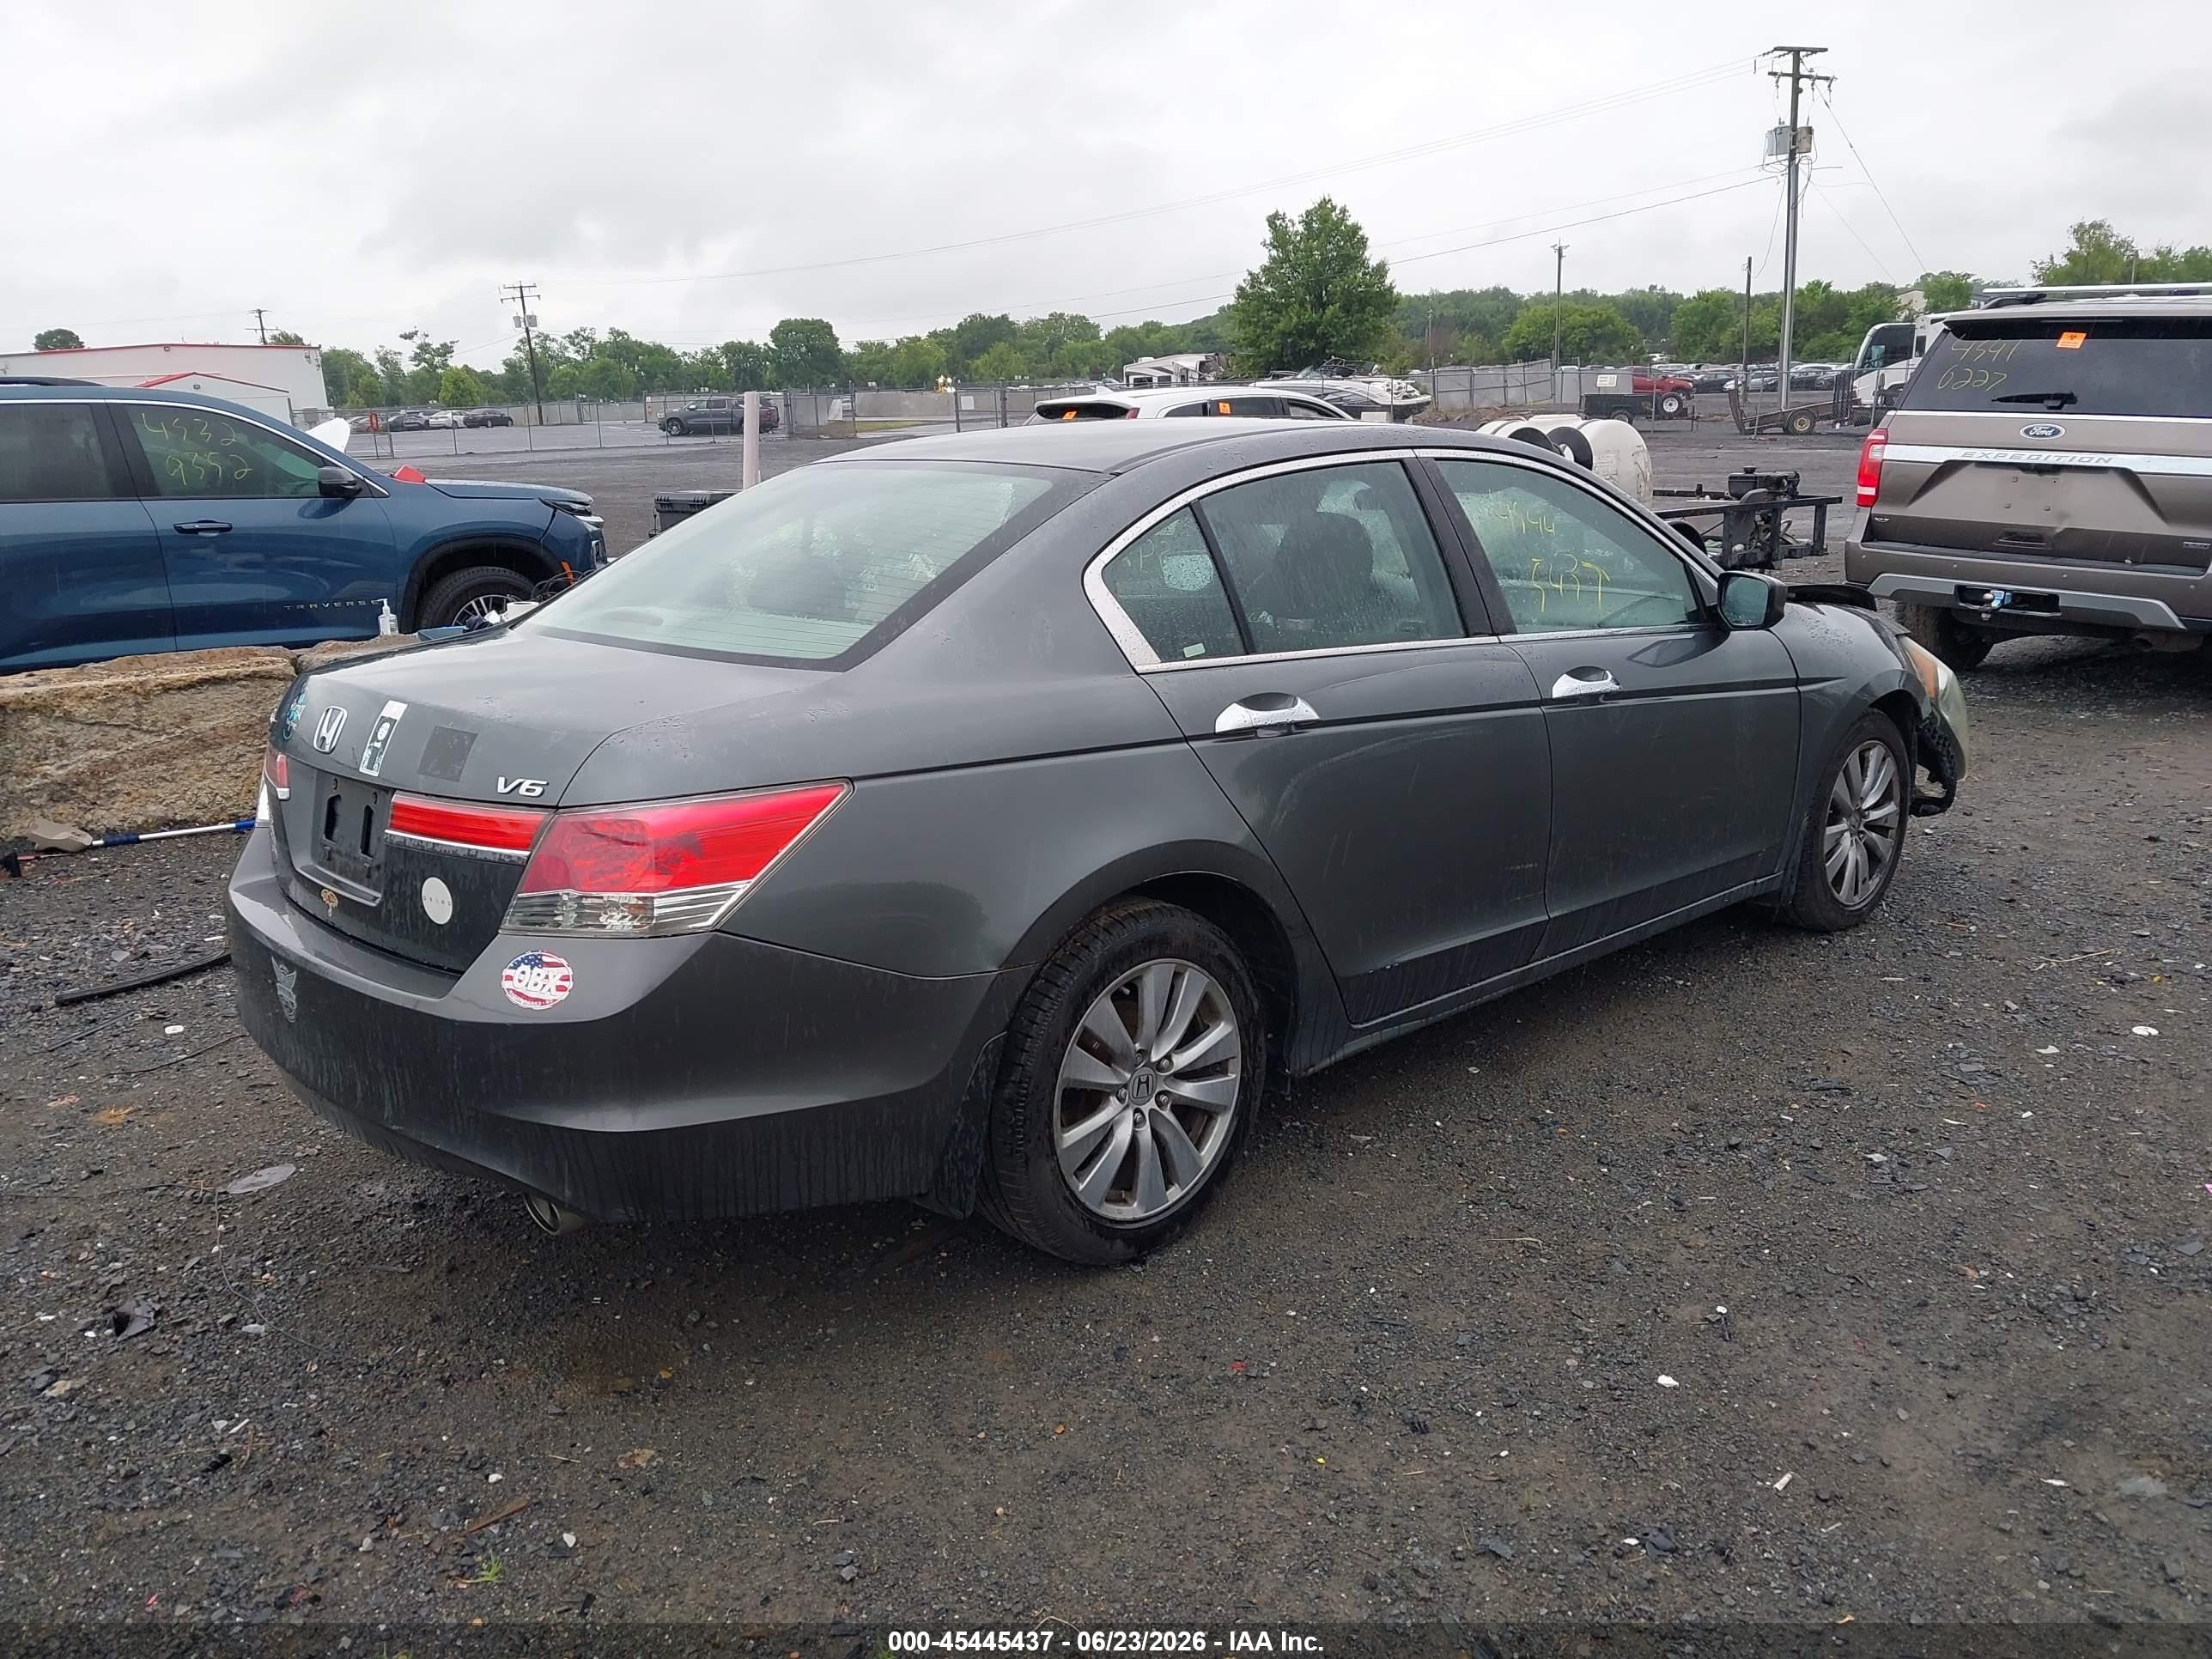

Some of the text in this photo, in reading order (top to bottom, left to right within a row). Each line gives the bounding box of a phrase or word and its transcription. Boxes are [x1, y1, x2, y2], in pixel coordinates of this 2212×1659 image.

[1938, 364, 2008, 392] 6227
[141, 412, 235, 446] 4532
[166, 451, 253, 486] 9352
[1961, 451, 2114, 465] EXPEDITION
[283, 599, 380, 611] TRAVERSE
[497, 776, 549, 797] V6
[513, 964, 563, 997] OBX
